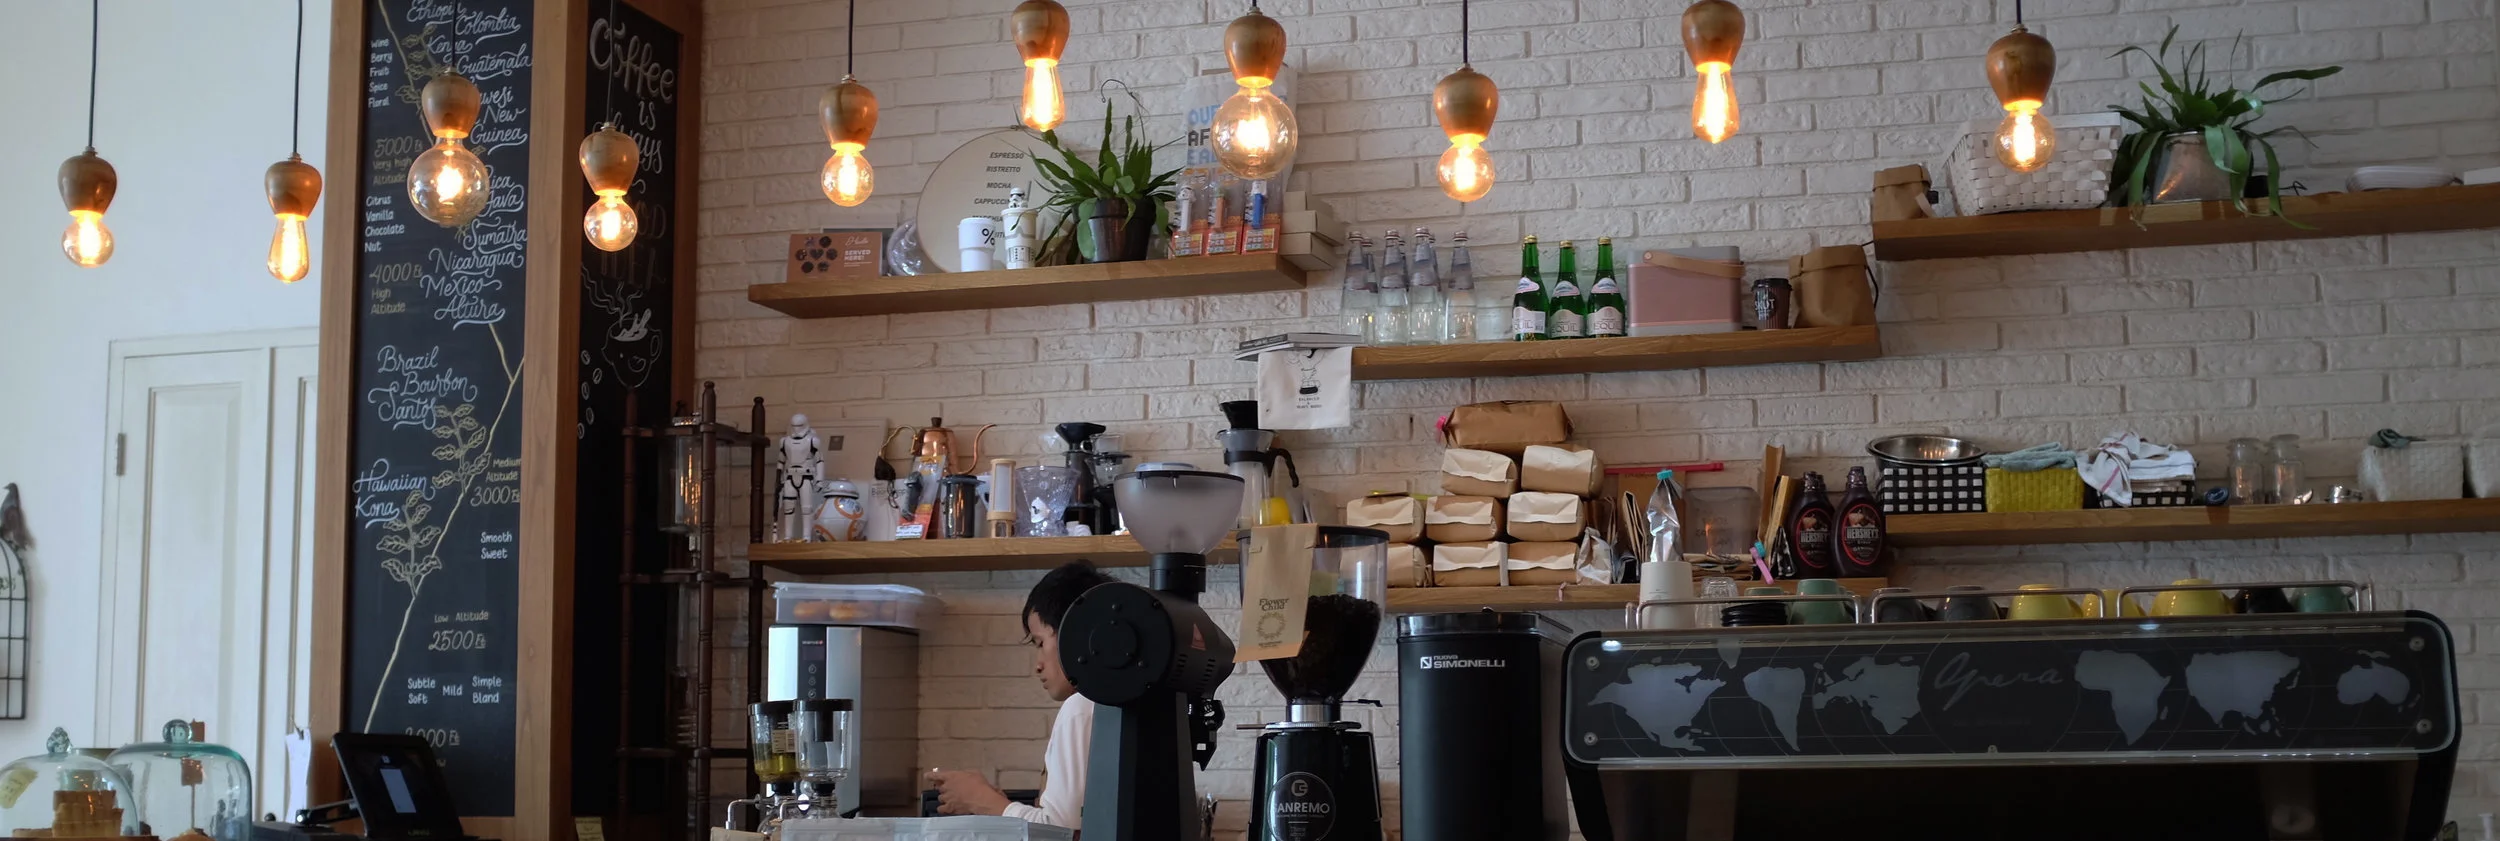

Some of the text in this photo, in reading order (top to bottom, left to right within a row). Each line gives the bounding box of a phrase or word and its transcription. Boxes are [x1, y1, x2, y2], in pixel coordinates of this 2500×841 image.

[455, 7, 521, 40] Colombia
[371, 53, 393, 63] Berry
[456, 43, 533, 76] Guatemala
[589, 18, 674, 104] Coffee
[370, 66, 390, 77] Fruit
[369, 82, 388, 93] Spice
[368, 96, 390, 108] Floral
[482, 105, 526, 124] New
[639, 101, 656, 131] is
[470, 123, 528, 150] Guinea
[374, 136, 413, 158] 5000
[366, 195, 392, 206] Citrus
[366, 209, 394, 222] Vanilla
[365, 224, 405, 237] Chocolate
[463, 217, 528, 254] Sumatra
[364, 241, 382, 253] Nut
[428, 248, 524, 277] Nicaragua
[369, 262, 412, 285] 4000
[371, 288, 391, 301] High
[420, 274, 502, 298] Mexico
[370, 302, 406, 315] Altitude
[434, 295, 505, 325] Altura
[378, 345, 439, 375] Brazil
[400, 368, 478, 402] Bourbon
[353, 458, 436, 501] Hawaiian
[486, 472, 518, 483] Altitude
[470, 486, 511, 507] 3000
[355, 495, 400, 525] Kona
[481, 531, 512, 544] Smooth
[481, 547, 508, 560] Sweet
[1259, 598, 1290, 606] Flower
[1262, 602, 1285, 612] Child
[434, 610, 489, 624] Low Altitude
[428, 630, 474, 651] 2500
[1433, 659, 1506, 669] SIMONELLI
[407, 675, 502, 696] Subtle Mild Simple
[1934, 652, 2064, 712] Opera
[408, 692, 500, 705] Soft Bland
[1275, 802, 1330, 814] ANREMO
